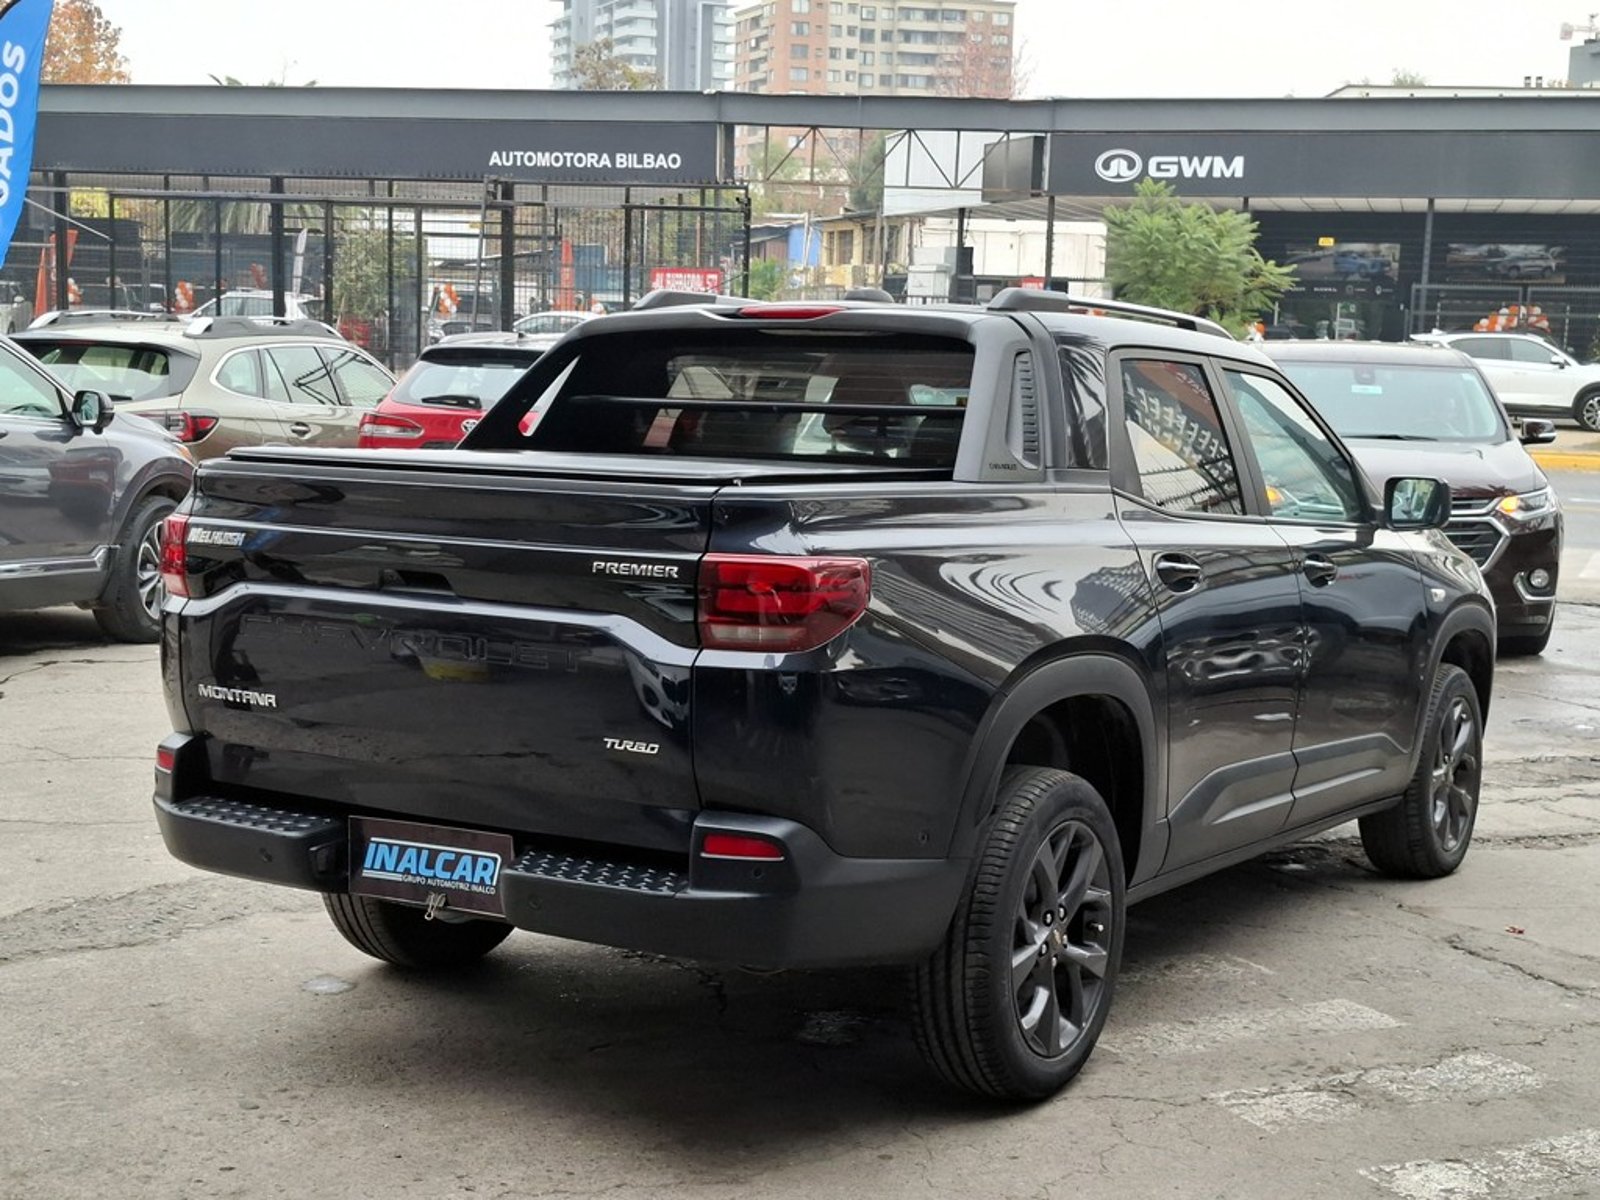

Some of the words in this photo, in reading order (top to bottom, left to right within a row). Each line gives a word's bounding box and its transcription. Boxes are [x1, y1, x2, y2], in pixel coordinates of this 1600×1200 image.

[489, 151, 612, 168] AUTOMOTORA
[615, 153, 682, 169] BILBAO
[1148, 156, 1245, 178] GWM
[592, 561, 679, 579] PREMIER
[198, 683, 277, 708] MONTANA
[603, 737, 660, 754] TURBO
[363, 842, 495, 885] INALCAR
[402, 874, 426, 886] GRUPO
[427, 878, 469, 892] AUTOMOTRIZ
[470, 884, 497, 896] INALCO
